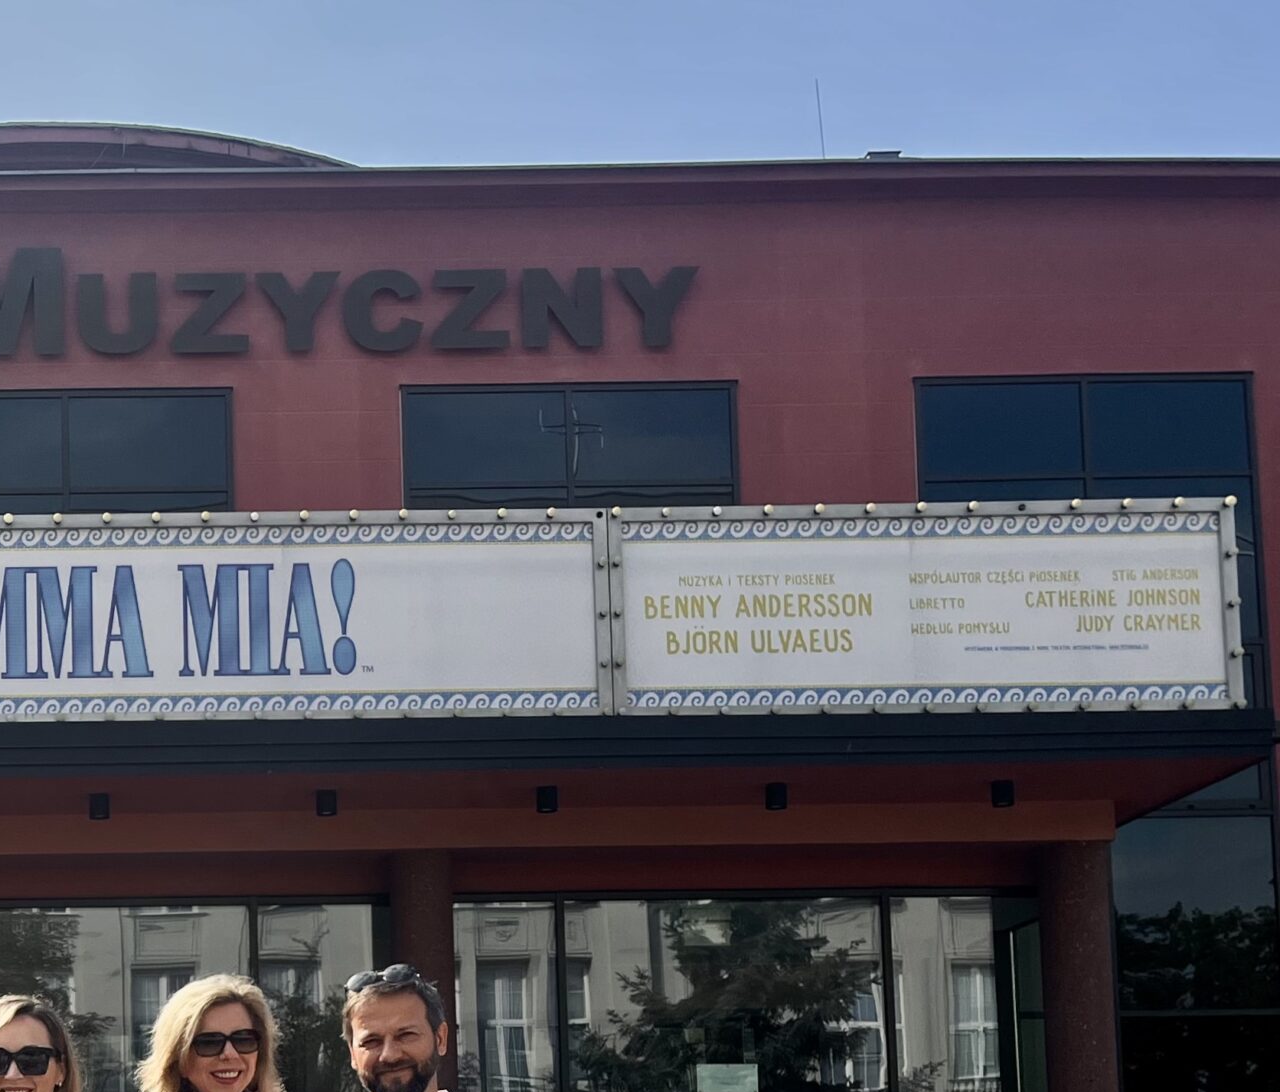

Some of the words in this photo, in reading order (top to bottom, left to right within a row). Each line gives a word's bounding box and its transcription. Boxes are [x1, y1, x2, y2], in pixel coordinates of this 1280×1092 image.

[678, 574, 723, 587] MUZYKA
[737, 575, 779, 586] TEKSTY
[1142, 569, 1199, 580] ANDERSON
[644, 594, 721, 619] BENNY
[736, 593, 872, 618] ANDERSSON
[1127, 589, 1200, 606] JOHNSON
[178, 559, 356, 677] MIA!
[911, 623, 953, 634] WEDŁUG
[1076, 615, 1115, 632] JUDY
[1123, 614, 1201, 632] CRAYMER
[666, 625, 738, 655] BJÖRN
[750, 628, 852, 653] ULVAEUS
